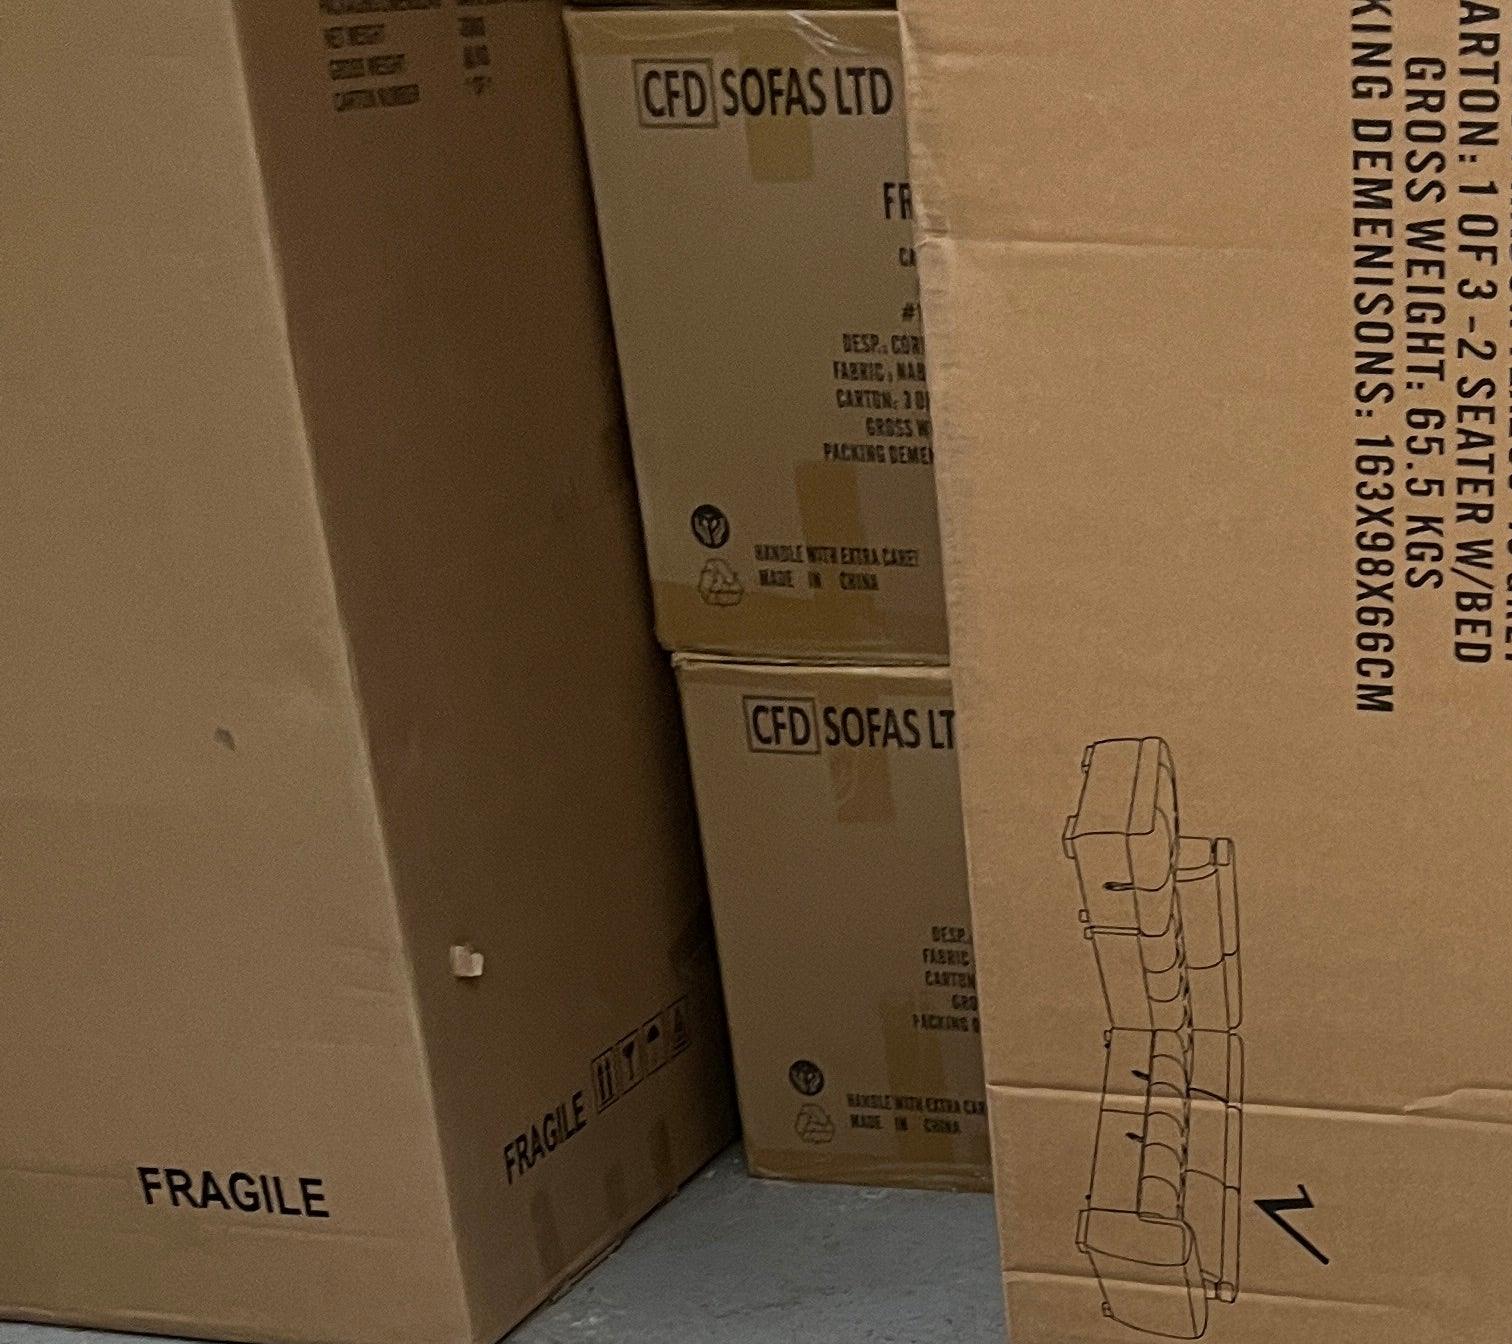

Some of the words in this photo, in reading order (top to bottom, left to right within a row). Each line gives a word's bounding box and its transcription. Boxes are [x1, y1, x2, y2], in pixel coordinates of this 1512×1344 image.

[643, 69, 708, 117] CFD
[720, 66, 827, 116] SOFAS
[834, 66, 894, 115] LTD
[1404, 57, 1447, 204] GROSS
[883, 181, 913, 220] FR
[1458, 180, 1499, 195] 1
[1351, 118, 1395, 417] DEMENISONS:
[1457, 213, 1499, 266] OF
[1405, 218, 1447, 390] WEIGHT:
[1457, 278, 1498, 300] 3
[1404, 408, 1447, 497] 65.5
[1456, 376, 1496, 525] SEATER
[1355, 434, 1395, 712] 163X98X66CM
[1404, 515, 1445, 590] KGS
[1450, 538, 1495, 664] W/BED
[752, 704, 812, 746] CFD
[823, 706, 921, 749] SOFAS
[502, 1089, 589, 1185] FRAGILE
[136, 1165, 330, 1218] FRAGILE
